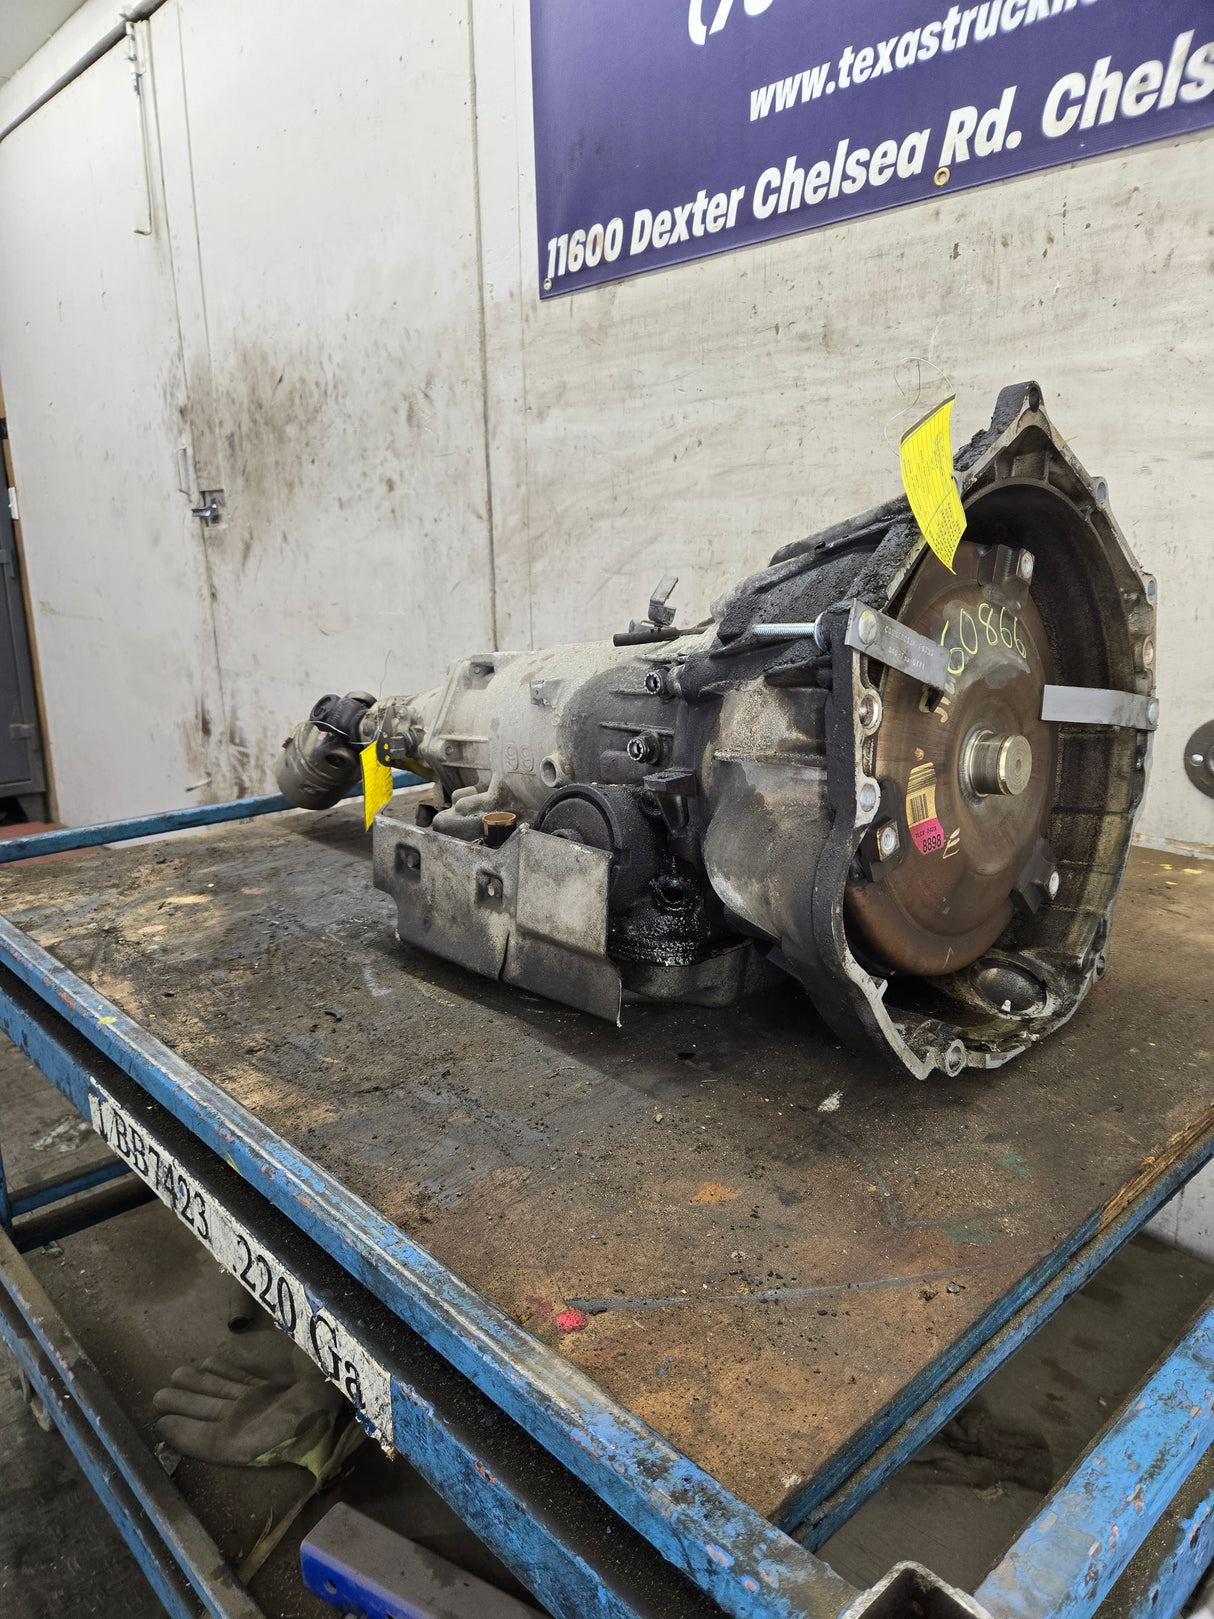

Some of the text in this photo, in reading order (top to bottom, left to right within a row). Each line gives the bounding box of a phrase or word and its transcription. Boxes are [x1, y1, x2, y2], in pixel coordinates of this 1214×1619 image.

[547, 217, 624, 279] 11600
[630, 185, 746, 256] Dexter
[752, 128, 931, 220] Chelsea
[938, 86, 1023, 168] Rd.
[922, 833, 942, 853] 8898
[309, 1314, 367, 1411] Ga
